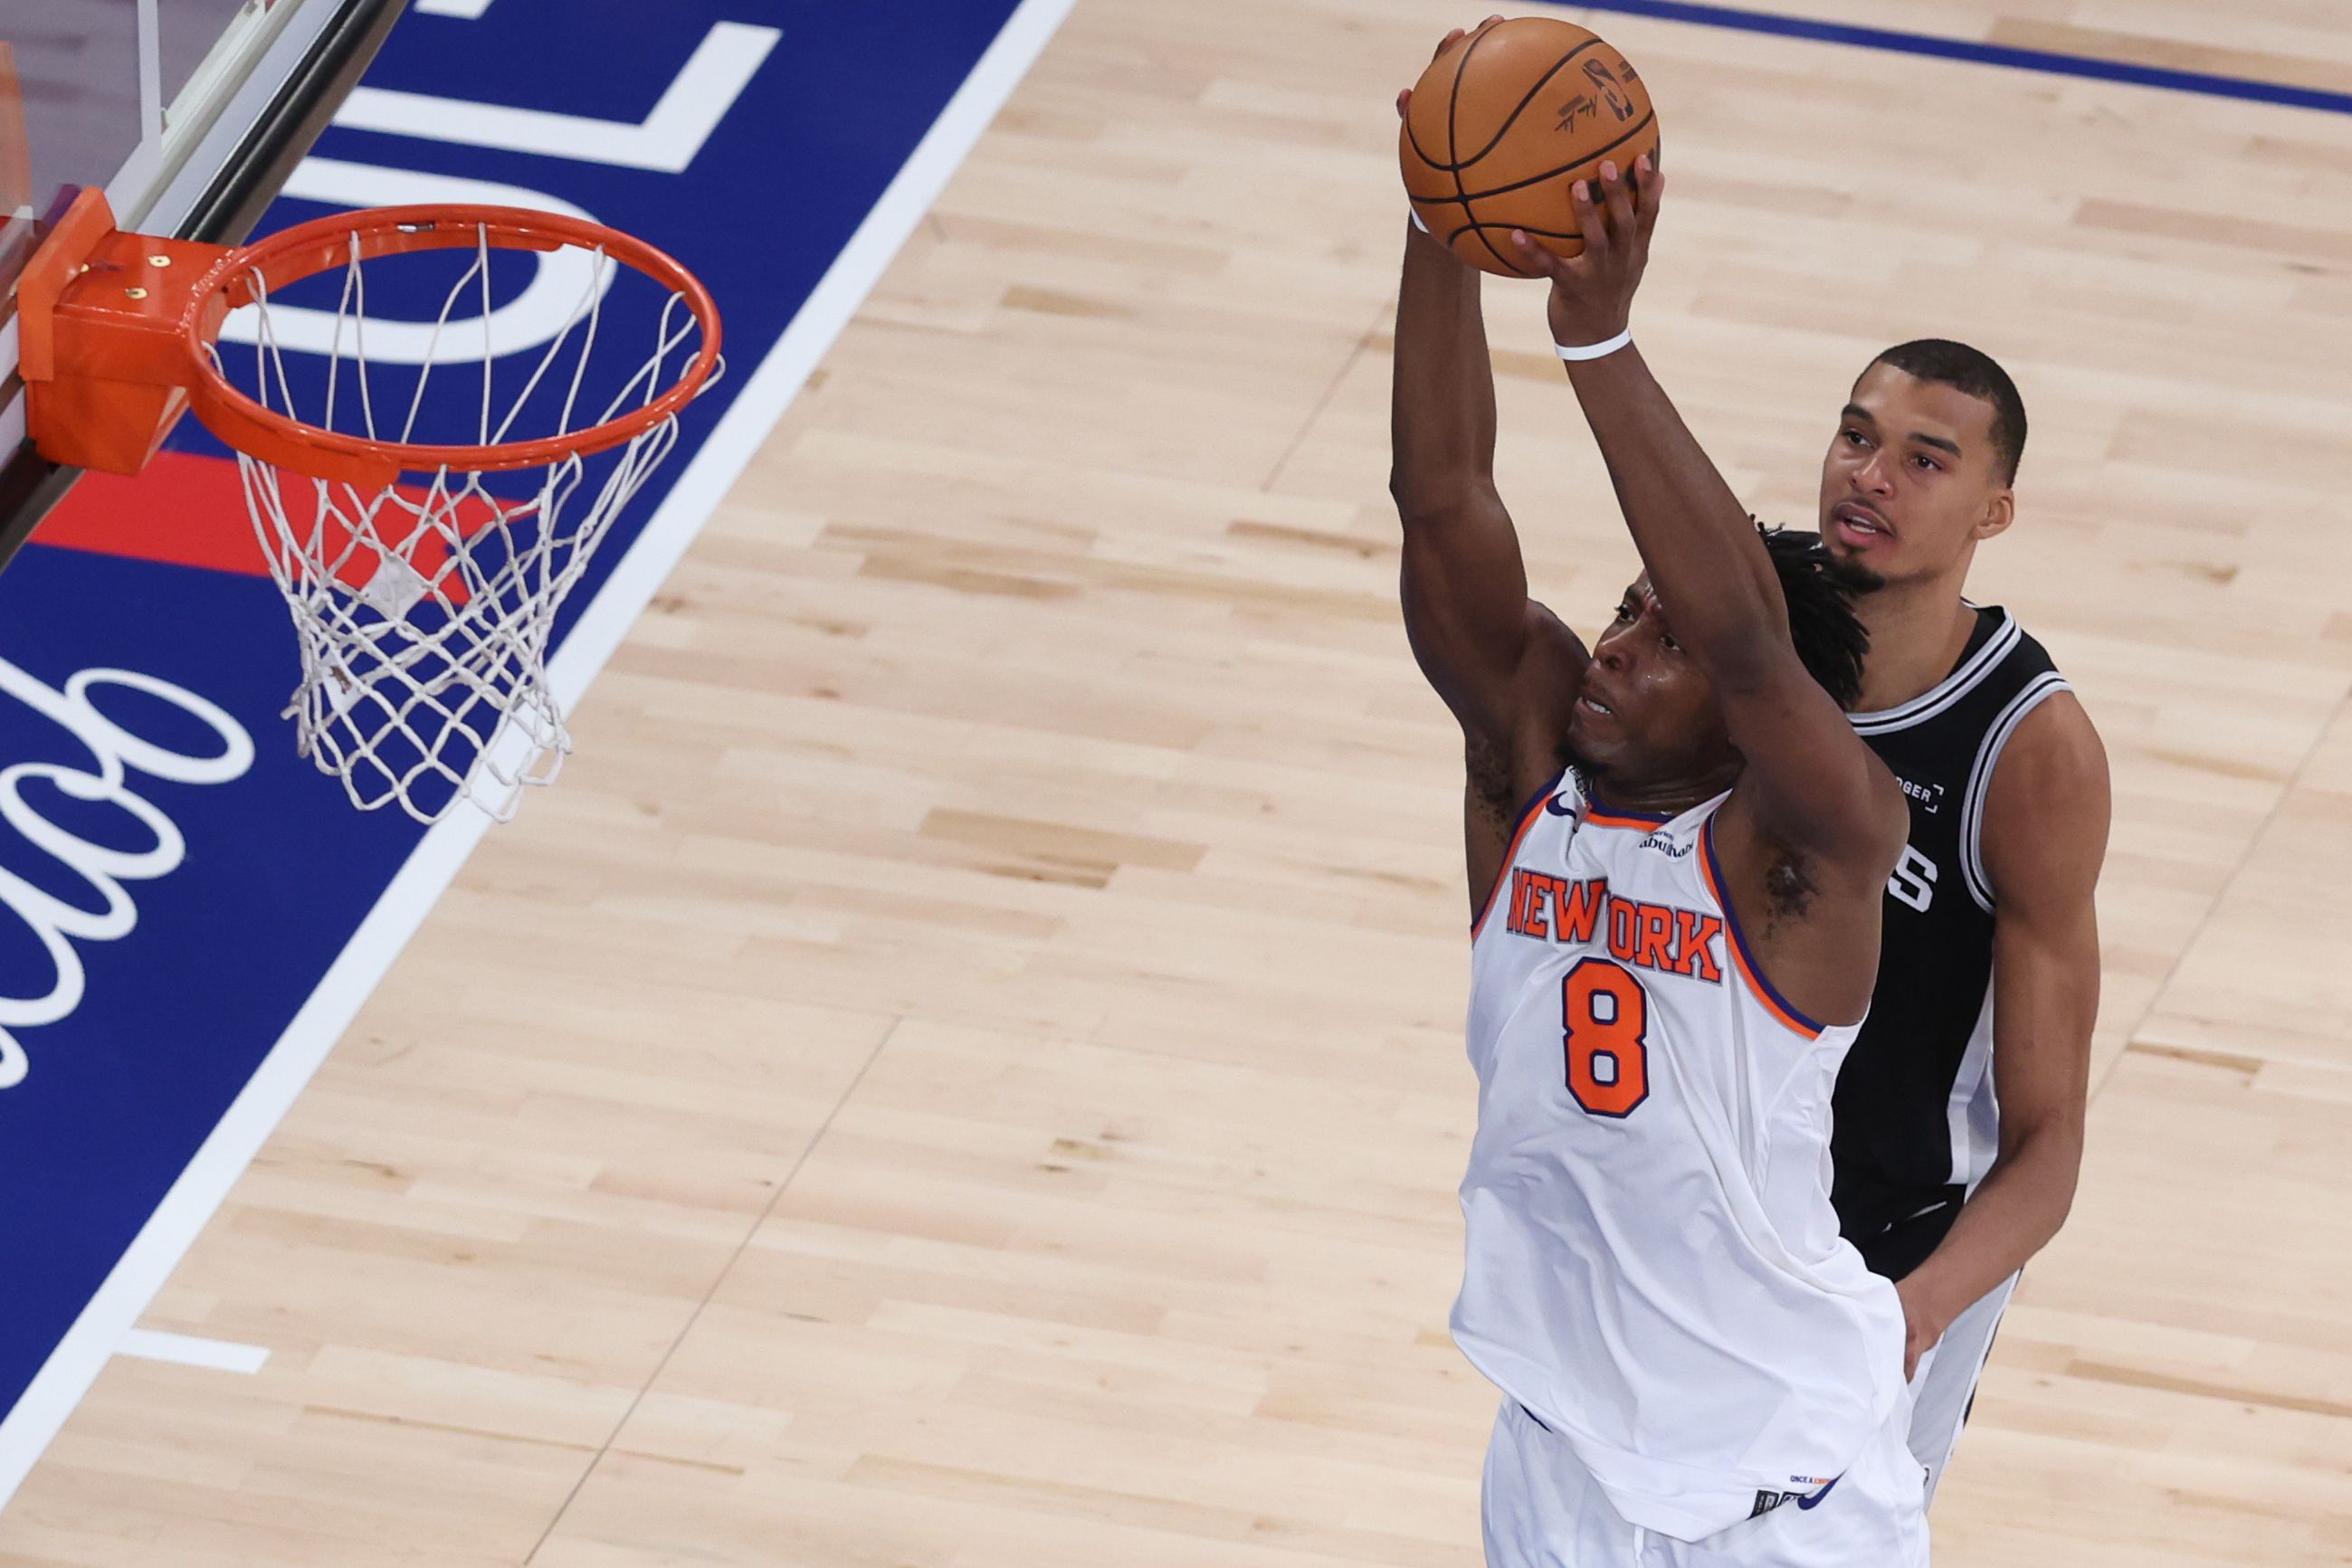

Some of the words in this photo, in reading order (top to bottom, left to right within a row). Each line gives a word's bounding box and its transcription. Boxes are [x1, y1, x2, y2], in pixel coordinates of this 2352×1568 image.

[1506, 866, 1608, 945] NEW
[1605, 891, 1723, 987] ORK
[1562, 956, 1649, 1119] 8
